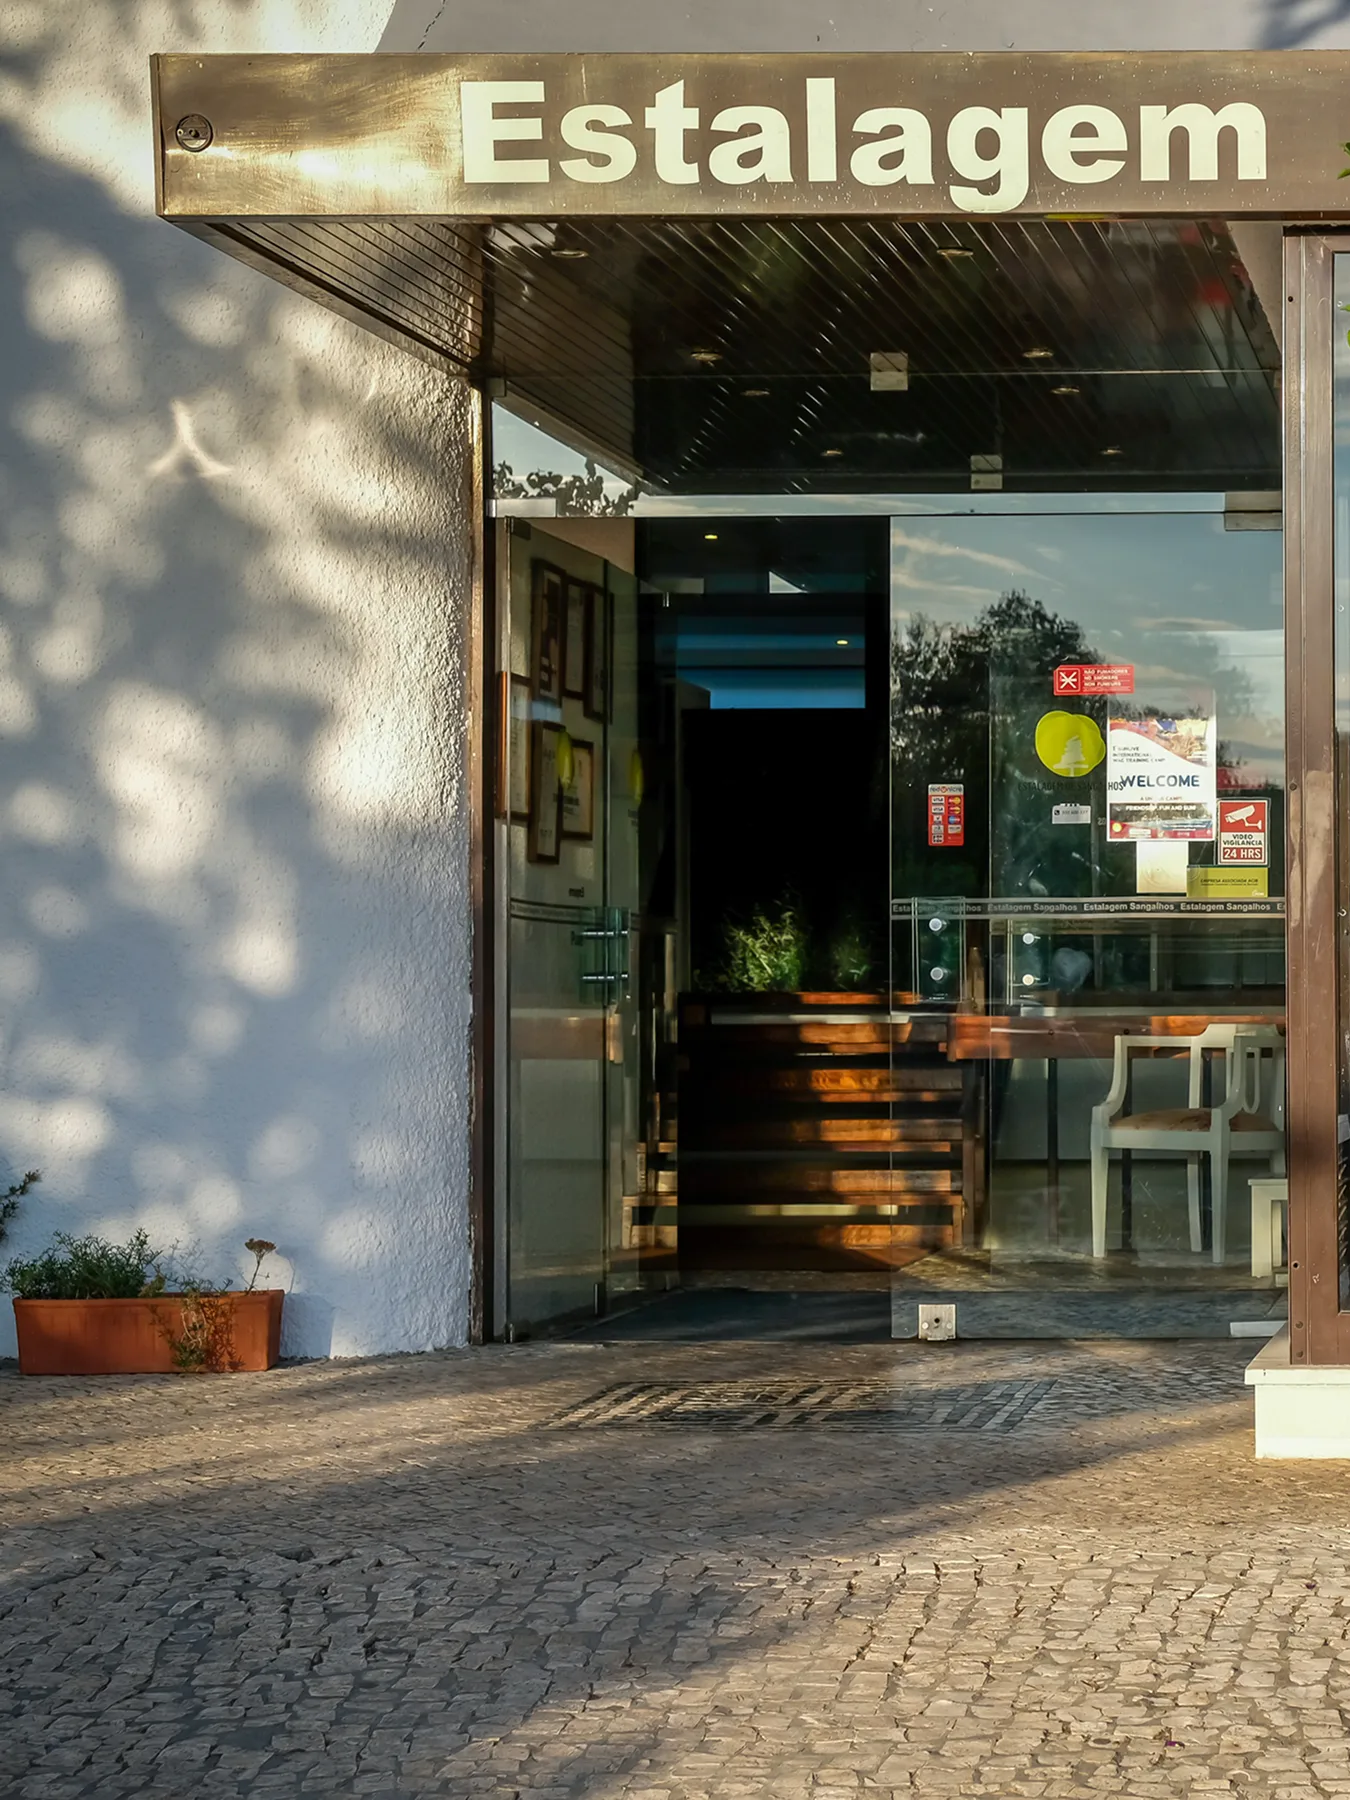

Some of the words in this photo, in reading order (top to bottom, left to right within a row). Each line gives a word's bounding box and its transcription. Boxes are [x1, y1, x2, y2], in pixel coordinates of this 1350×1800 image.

[460, 77, 1267, 214] Estalagem
[1120, 775, 1200, 787] WELCOME
[1224, 848, 1237, 859] 24
[1240, 848, 1262, 859] HRS
[893, 904, 936, 913] Estagem
[938, 903, 982, 913] Sanghos
[987, 903, 1032, 912] Estalagem
[1033, 903, 1078, 913] Sangalhos
[1083, 903, 1128, 912] Estalagem
[1129, 901, 1175, 912] Sangalhos
[1180, 902, 1225, 912] Estalagem
[1226, 902, 1271, 912] Sangalhos
